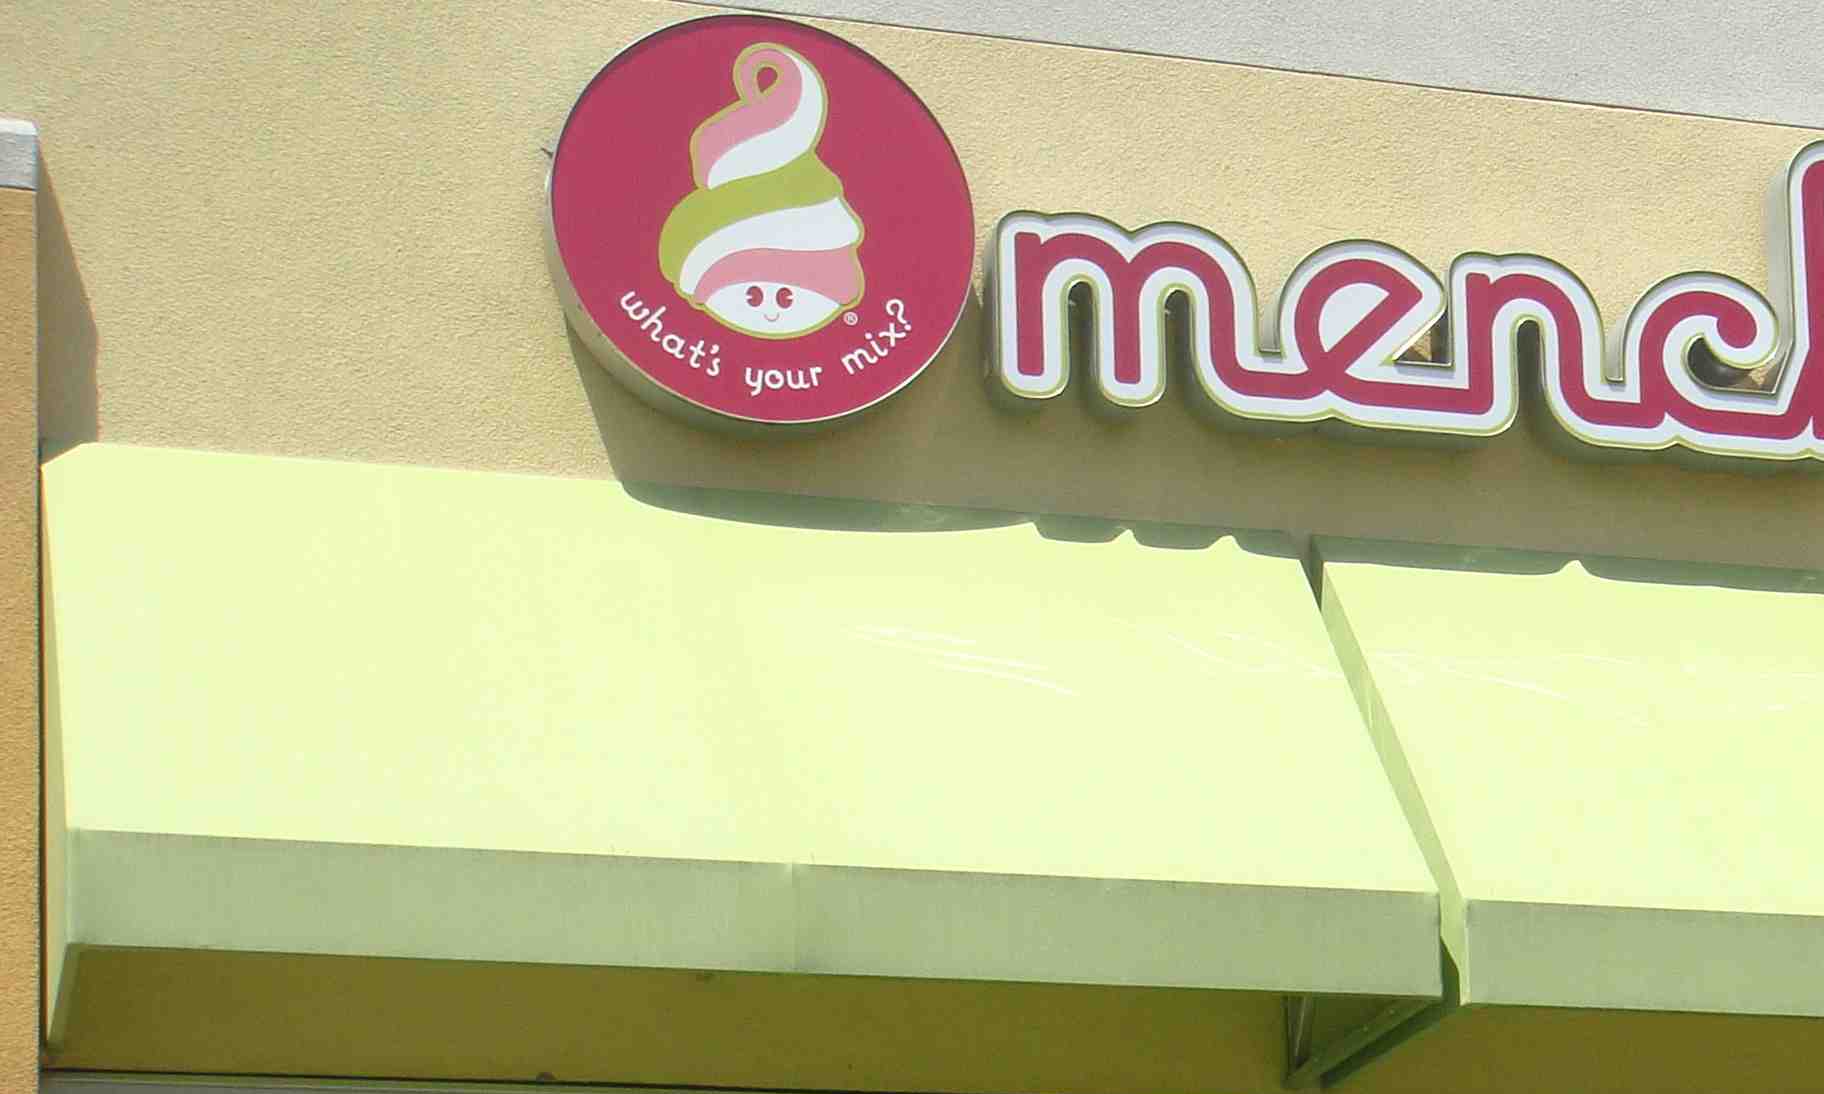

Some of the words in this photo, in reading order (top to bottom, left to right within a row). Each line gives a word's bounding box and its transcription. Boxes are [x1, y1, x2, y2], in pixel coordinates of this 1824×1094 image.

[619, 291, 721, 377] what's
[744, 366, 823, 397] your
[841, 299, 912, 375] mix?
